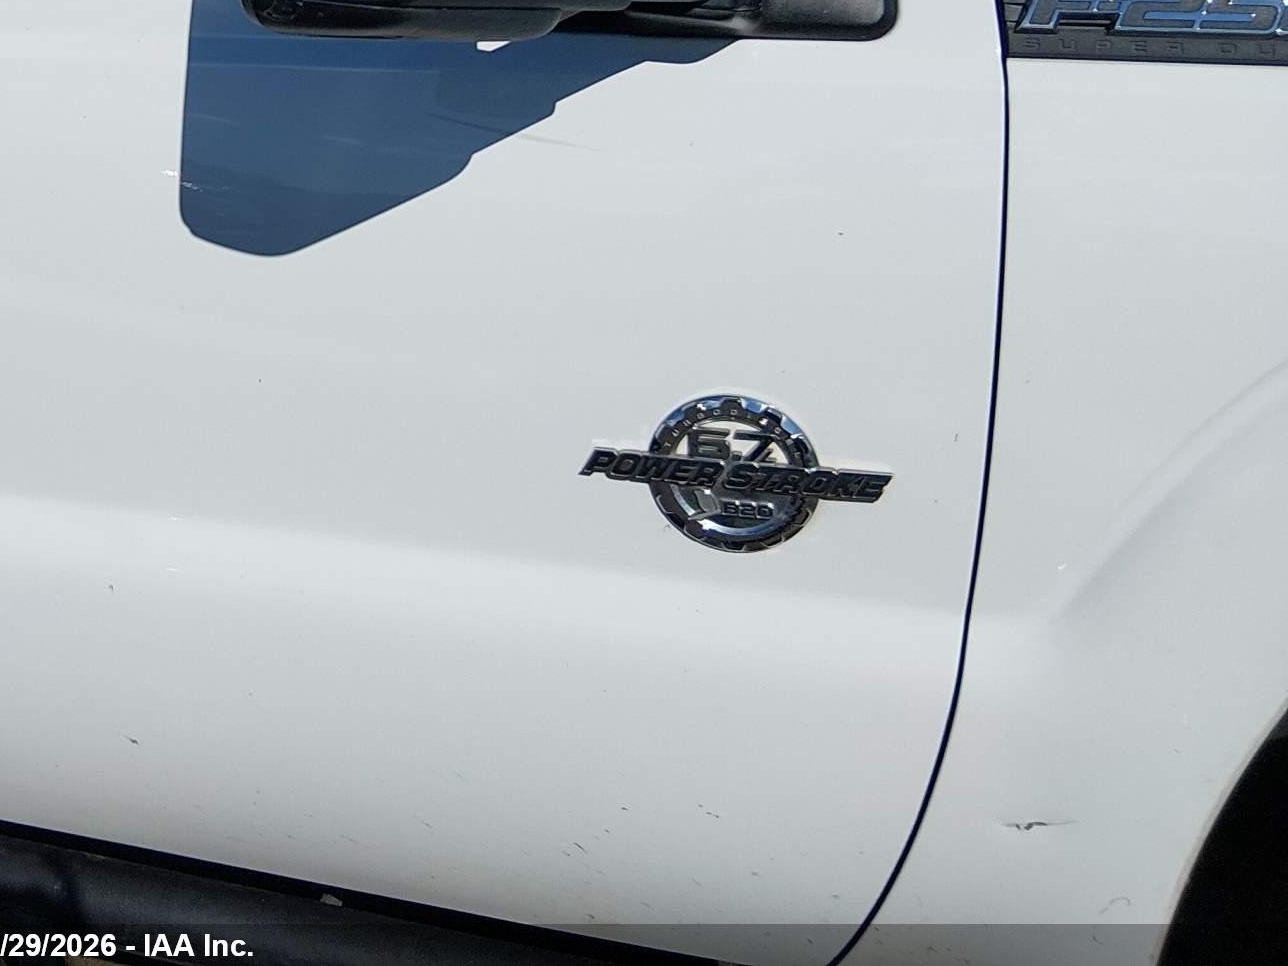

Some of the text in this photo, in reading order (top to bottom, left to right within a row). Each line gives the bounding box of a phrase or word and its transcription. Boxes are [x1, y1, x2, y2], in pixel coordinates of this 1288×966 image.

[1022, 38, 1186, 55] SUPER
[578, 446, 896, 504] POWER STROKE
